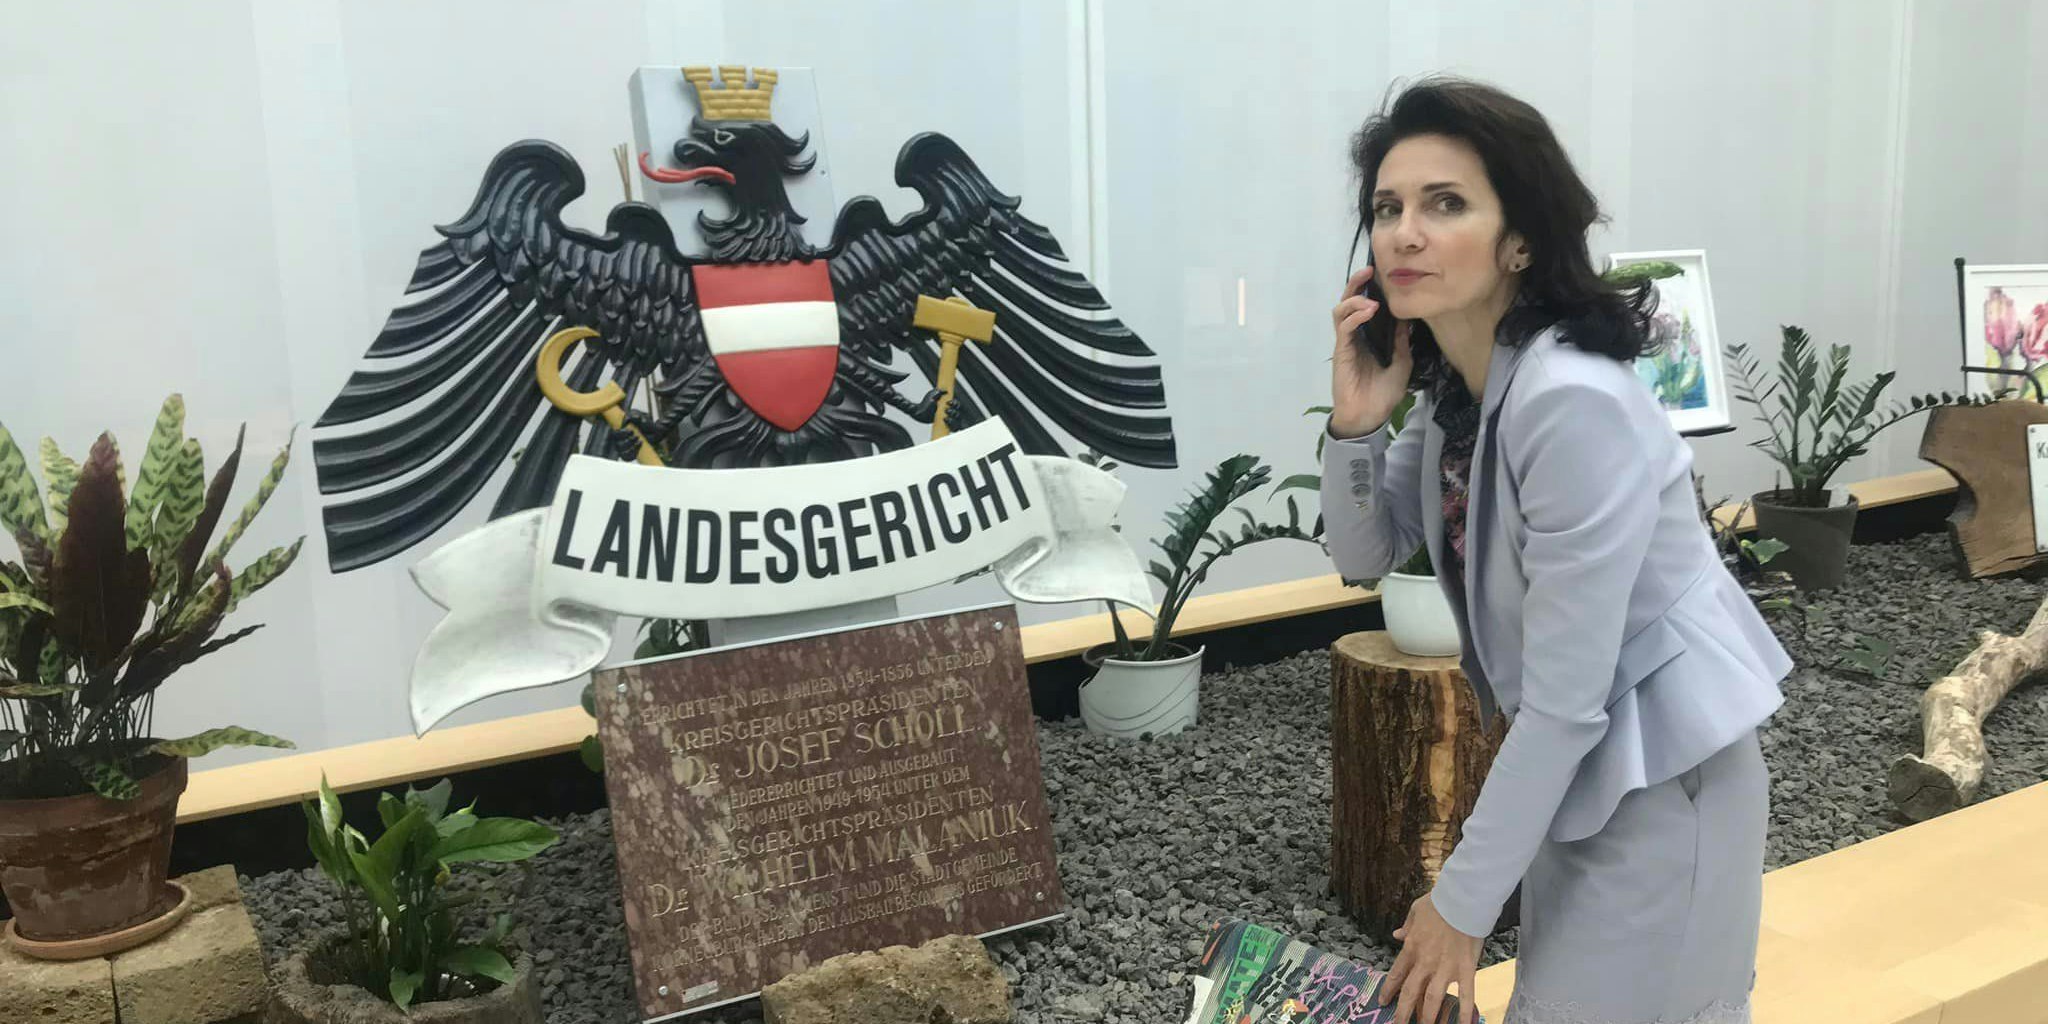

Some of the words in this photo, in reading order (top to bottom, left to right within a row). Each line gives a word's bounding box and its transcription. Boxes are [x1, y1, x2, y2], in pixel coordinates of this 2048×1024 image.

[552, 443, 1031, 584] LANDESGERICHT
[730, 725, 847, 779] JOSEF
[847, 763, 876, 784] UND
[757, 796, 815, 825] JAHREN
[941, 763, 971, 785] DEM
